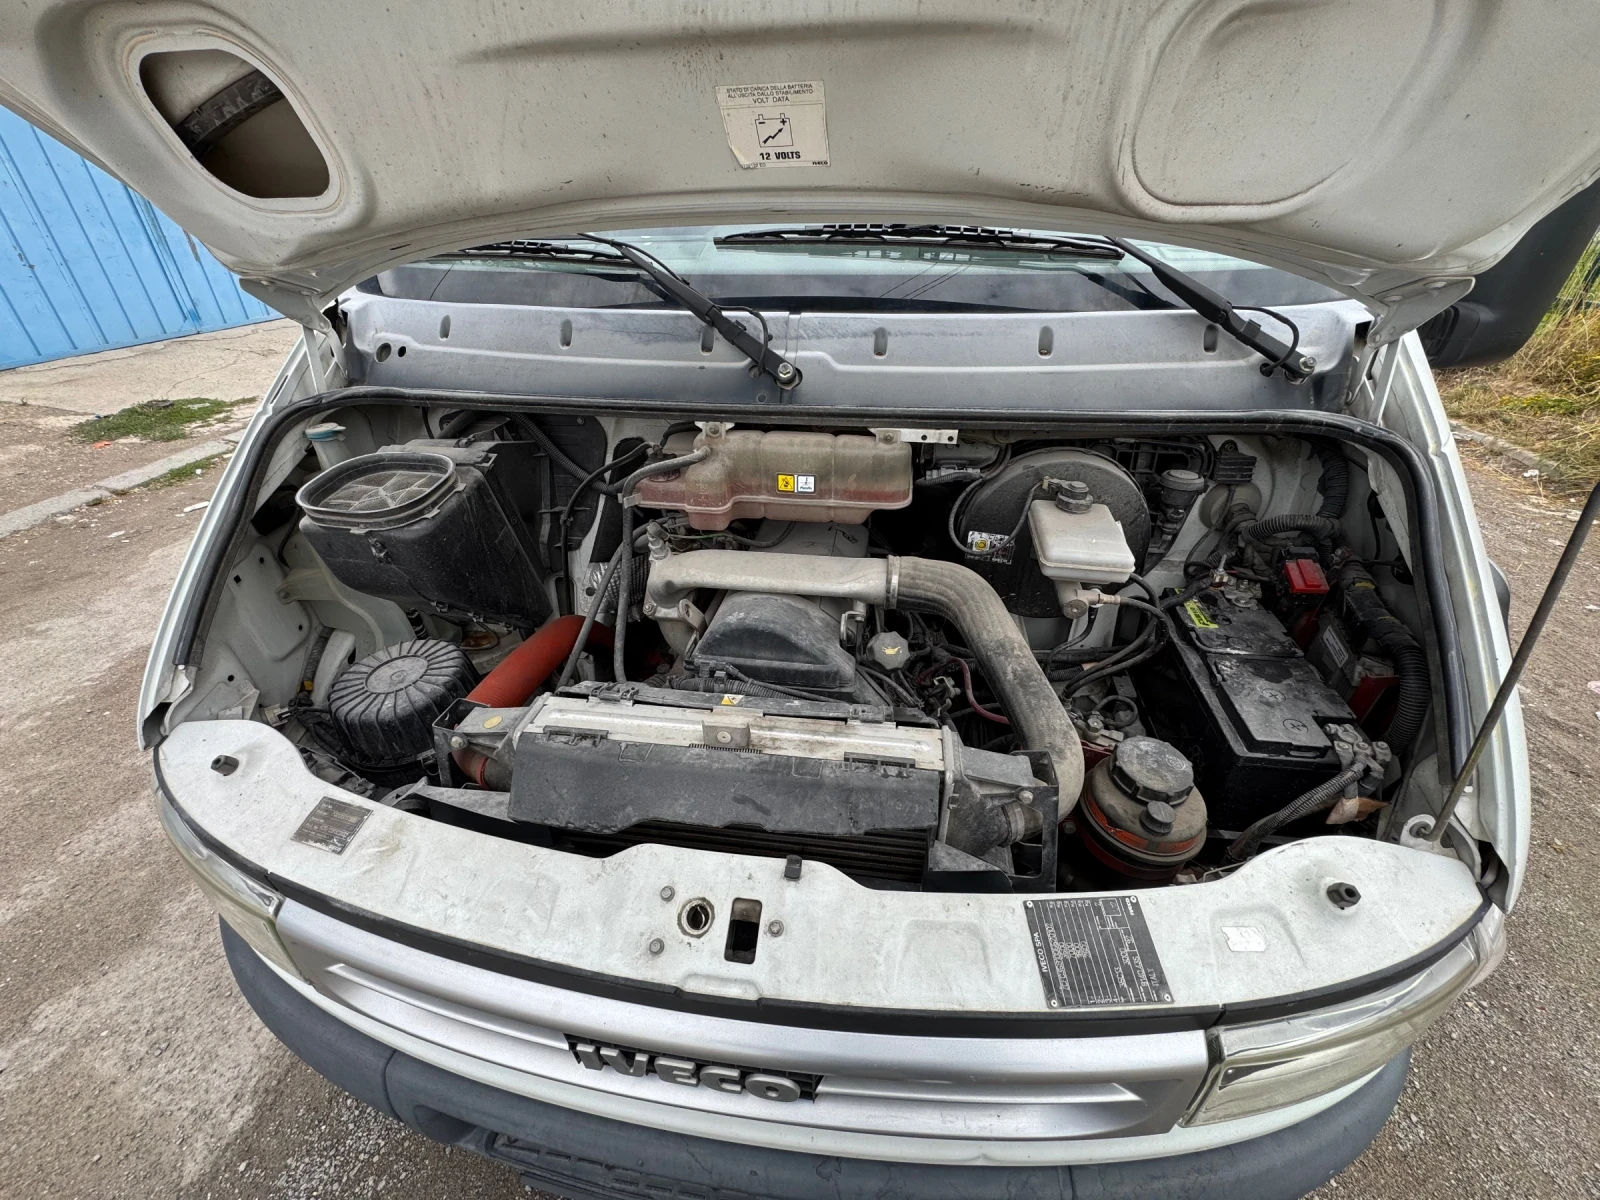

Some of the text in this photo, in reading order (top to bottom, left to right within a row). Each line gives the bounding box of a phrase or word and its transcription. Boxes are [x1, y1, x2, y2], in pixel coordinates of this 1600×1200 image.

[759, 151, 801, 160] 12 VOLTS
[1032, 931, 1048, 972] IVECO SPA
[1146, 967, 1160, 986] ITALY
[576, 1043, 801, 1102] IVECO
